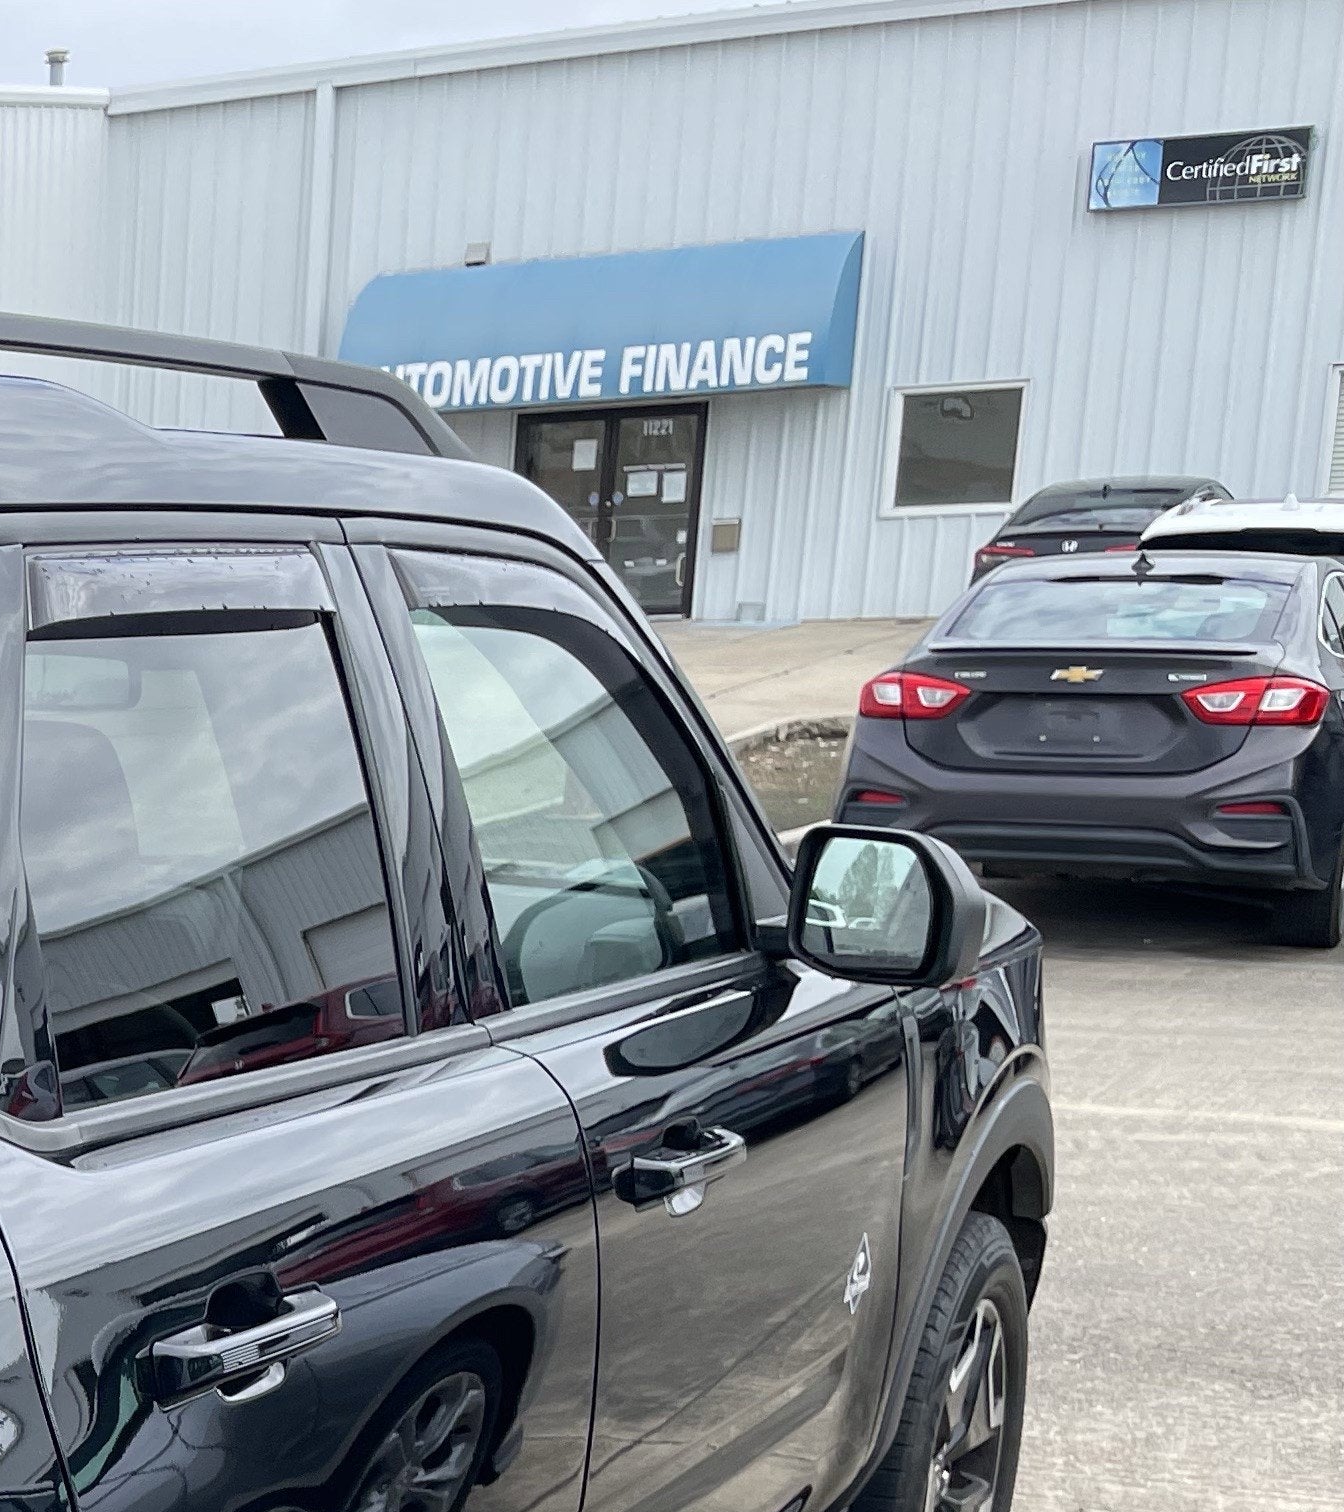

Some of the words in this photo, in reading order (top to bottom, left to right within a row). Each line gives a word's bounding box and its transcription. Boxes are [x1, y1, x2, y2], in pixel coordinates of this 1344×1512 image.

[1248, 171, 1298, 184] NETWORK
[381, 349, 606, 409] TOMOTIVE
[619, 331, 813, 395] FINANCE
